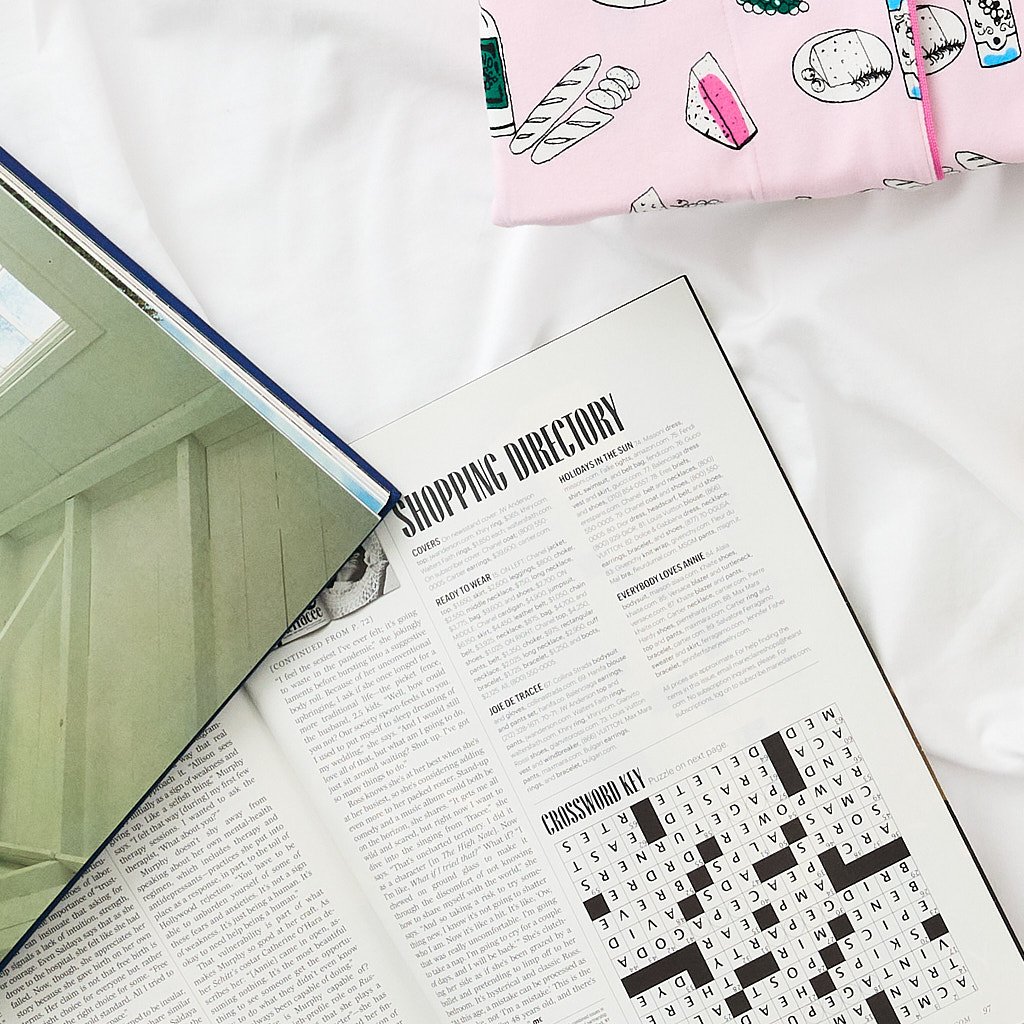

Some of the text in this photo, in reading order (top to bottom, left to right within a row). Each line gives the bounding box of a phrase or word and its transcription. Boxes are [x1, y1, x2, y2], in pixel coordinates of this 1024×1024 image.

[391, 392, 625, 538] SHOPPING DIRECTORY
[558, 441, 634, 483] HOLIDAYS IN THE SUN
[411, 537, 441, 557] COVERS
[435, 573, 492, 607] READY TO WEAR
[616, 551, 706, 601] EVERYBODY LOVES ANNIE
[488, 682, 544, 716] JOIE DE TRACEE
[647, 741, 728, 785] Puzzle on next page.
[541, 767, 645, 835] CROSSWORD KEY
[982, 1004, 991, 1015] 97
